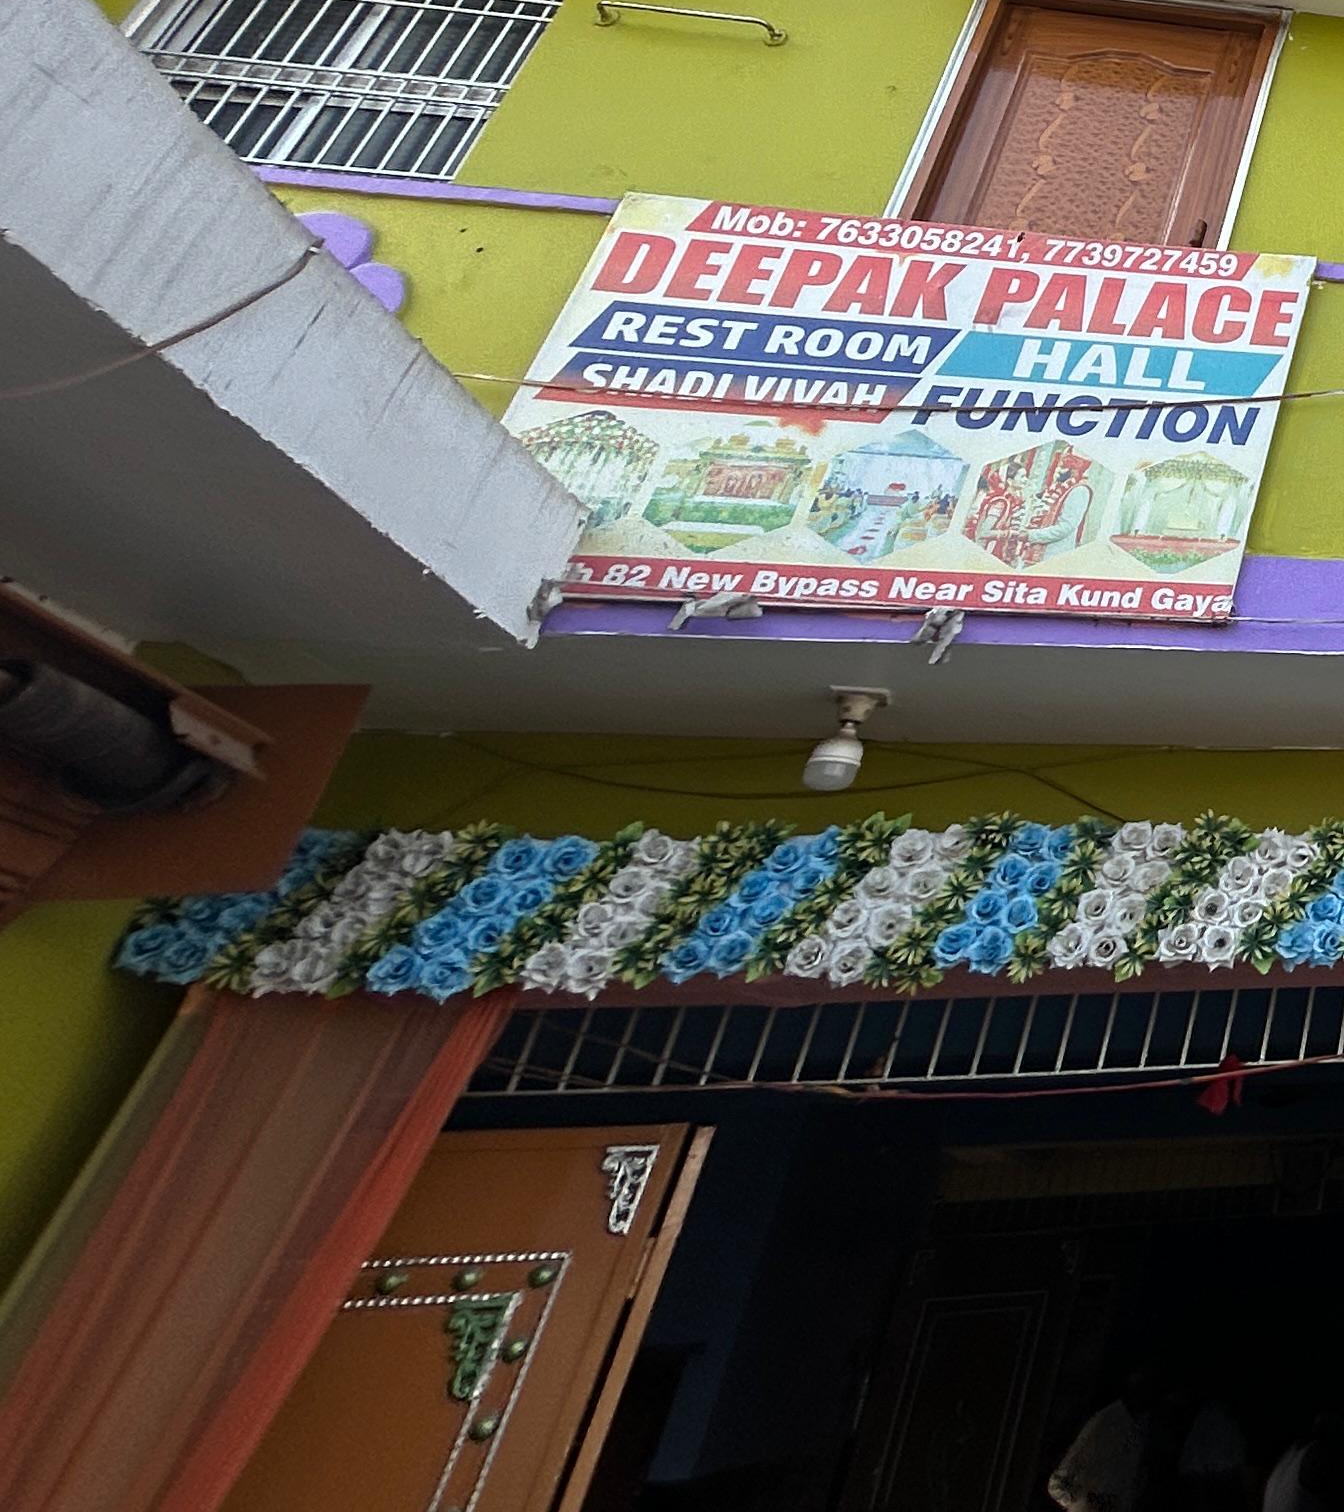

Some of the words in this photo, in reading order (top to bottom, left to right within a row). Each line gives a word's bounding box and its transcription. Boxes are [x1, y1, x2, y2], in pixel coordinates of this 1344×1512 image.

[710, 206, 808, 240] Mob:
[815, 218, 1031, 264] 7633058241,
[1045, 239, 1240, 278] 7739727459
[595, 232, 966, 321] DEEPAK
[973, 267, 1300, 348] PALACE
[601, 314, 760, 356] REST
[763, 327, 933, 365] ROOM
[1013, 338, 1208, 392] HALL
[582, 363, 734, 402] SHADI
[742, 375, 888, 413] VIVAH
[911, 384, 1262, 446] FUNCTION
[602, 564, 652, 588] 82
[657, 566, 742, 592] New
[758, 569, 877, 600] Bypass
[888, 575, 976, 602] Near
[983, 580, 1052, 606] Sita
[1058, 585, 1142, 610] Kund
[1151, 590, 1230, 618] Gaya
